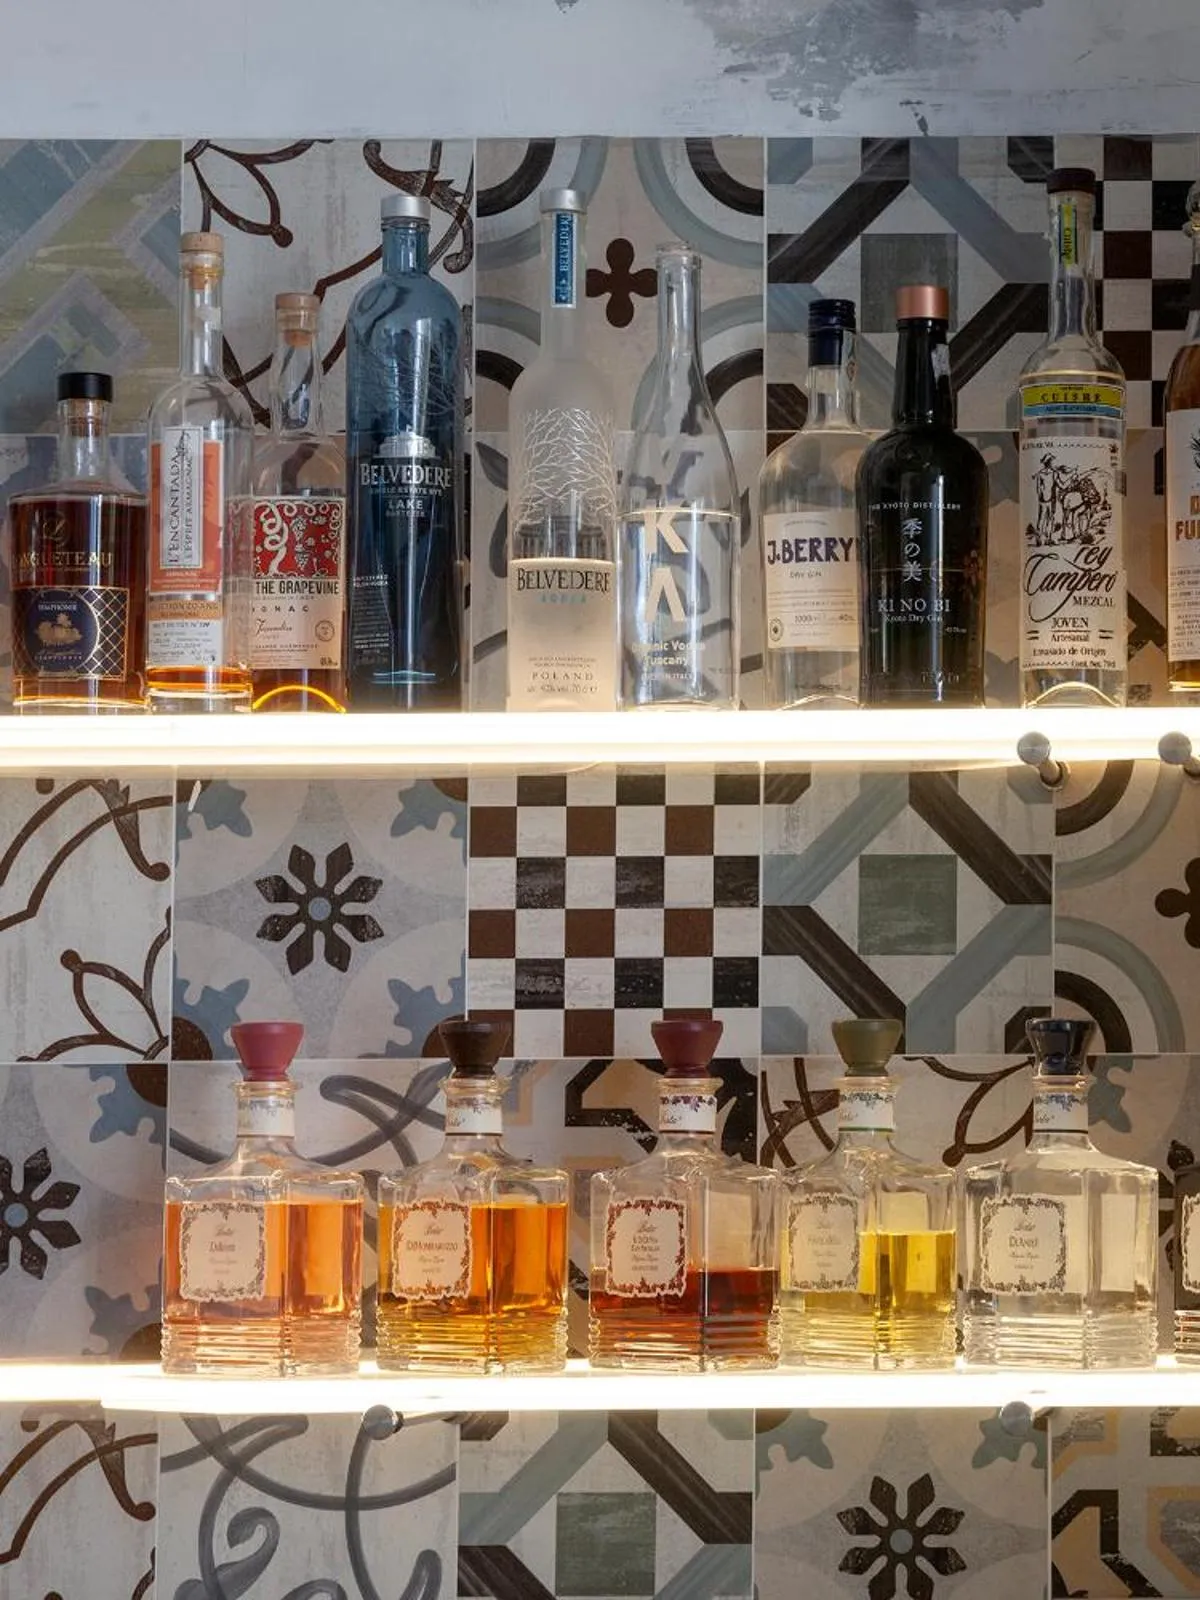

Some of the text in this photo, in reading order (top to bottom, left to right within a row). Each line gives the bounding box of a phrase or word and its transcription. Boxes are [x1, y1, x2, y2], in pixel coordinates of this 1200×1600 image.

[560, 214, 572, 273] BELVEDER
[360, 463, 452, 487] BELVEDERE
[388, 500, 423, 510] LAKE
[883, 502, 910, 510] KYOTO
[767, 536, 862, 565] J.BERRY
[902, 517, 922, 582] 季の美
[517, 567, 611, 592] BELVEDERE
[255, 581, 276, 594] THE
[279, 580, 340, 595] GRAPEVINE
[878, 599, 951, 613] KI NO BI
[1072, 595, 1115, 607] MEZCAL
[908, 614, 925, 624] Dry
[1051, 617, 1089, 628] JOVEN
[532, 672, 593, 681] POLAND
